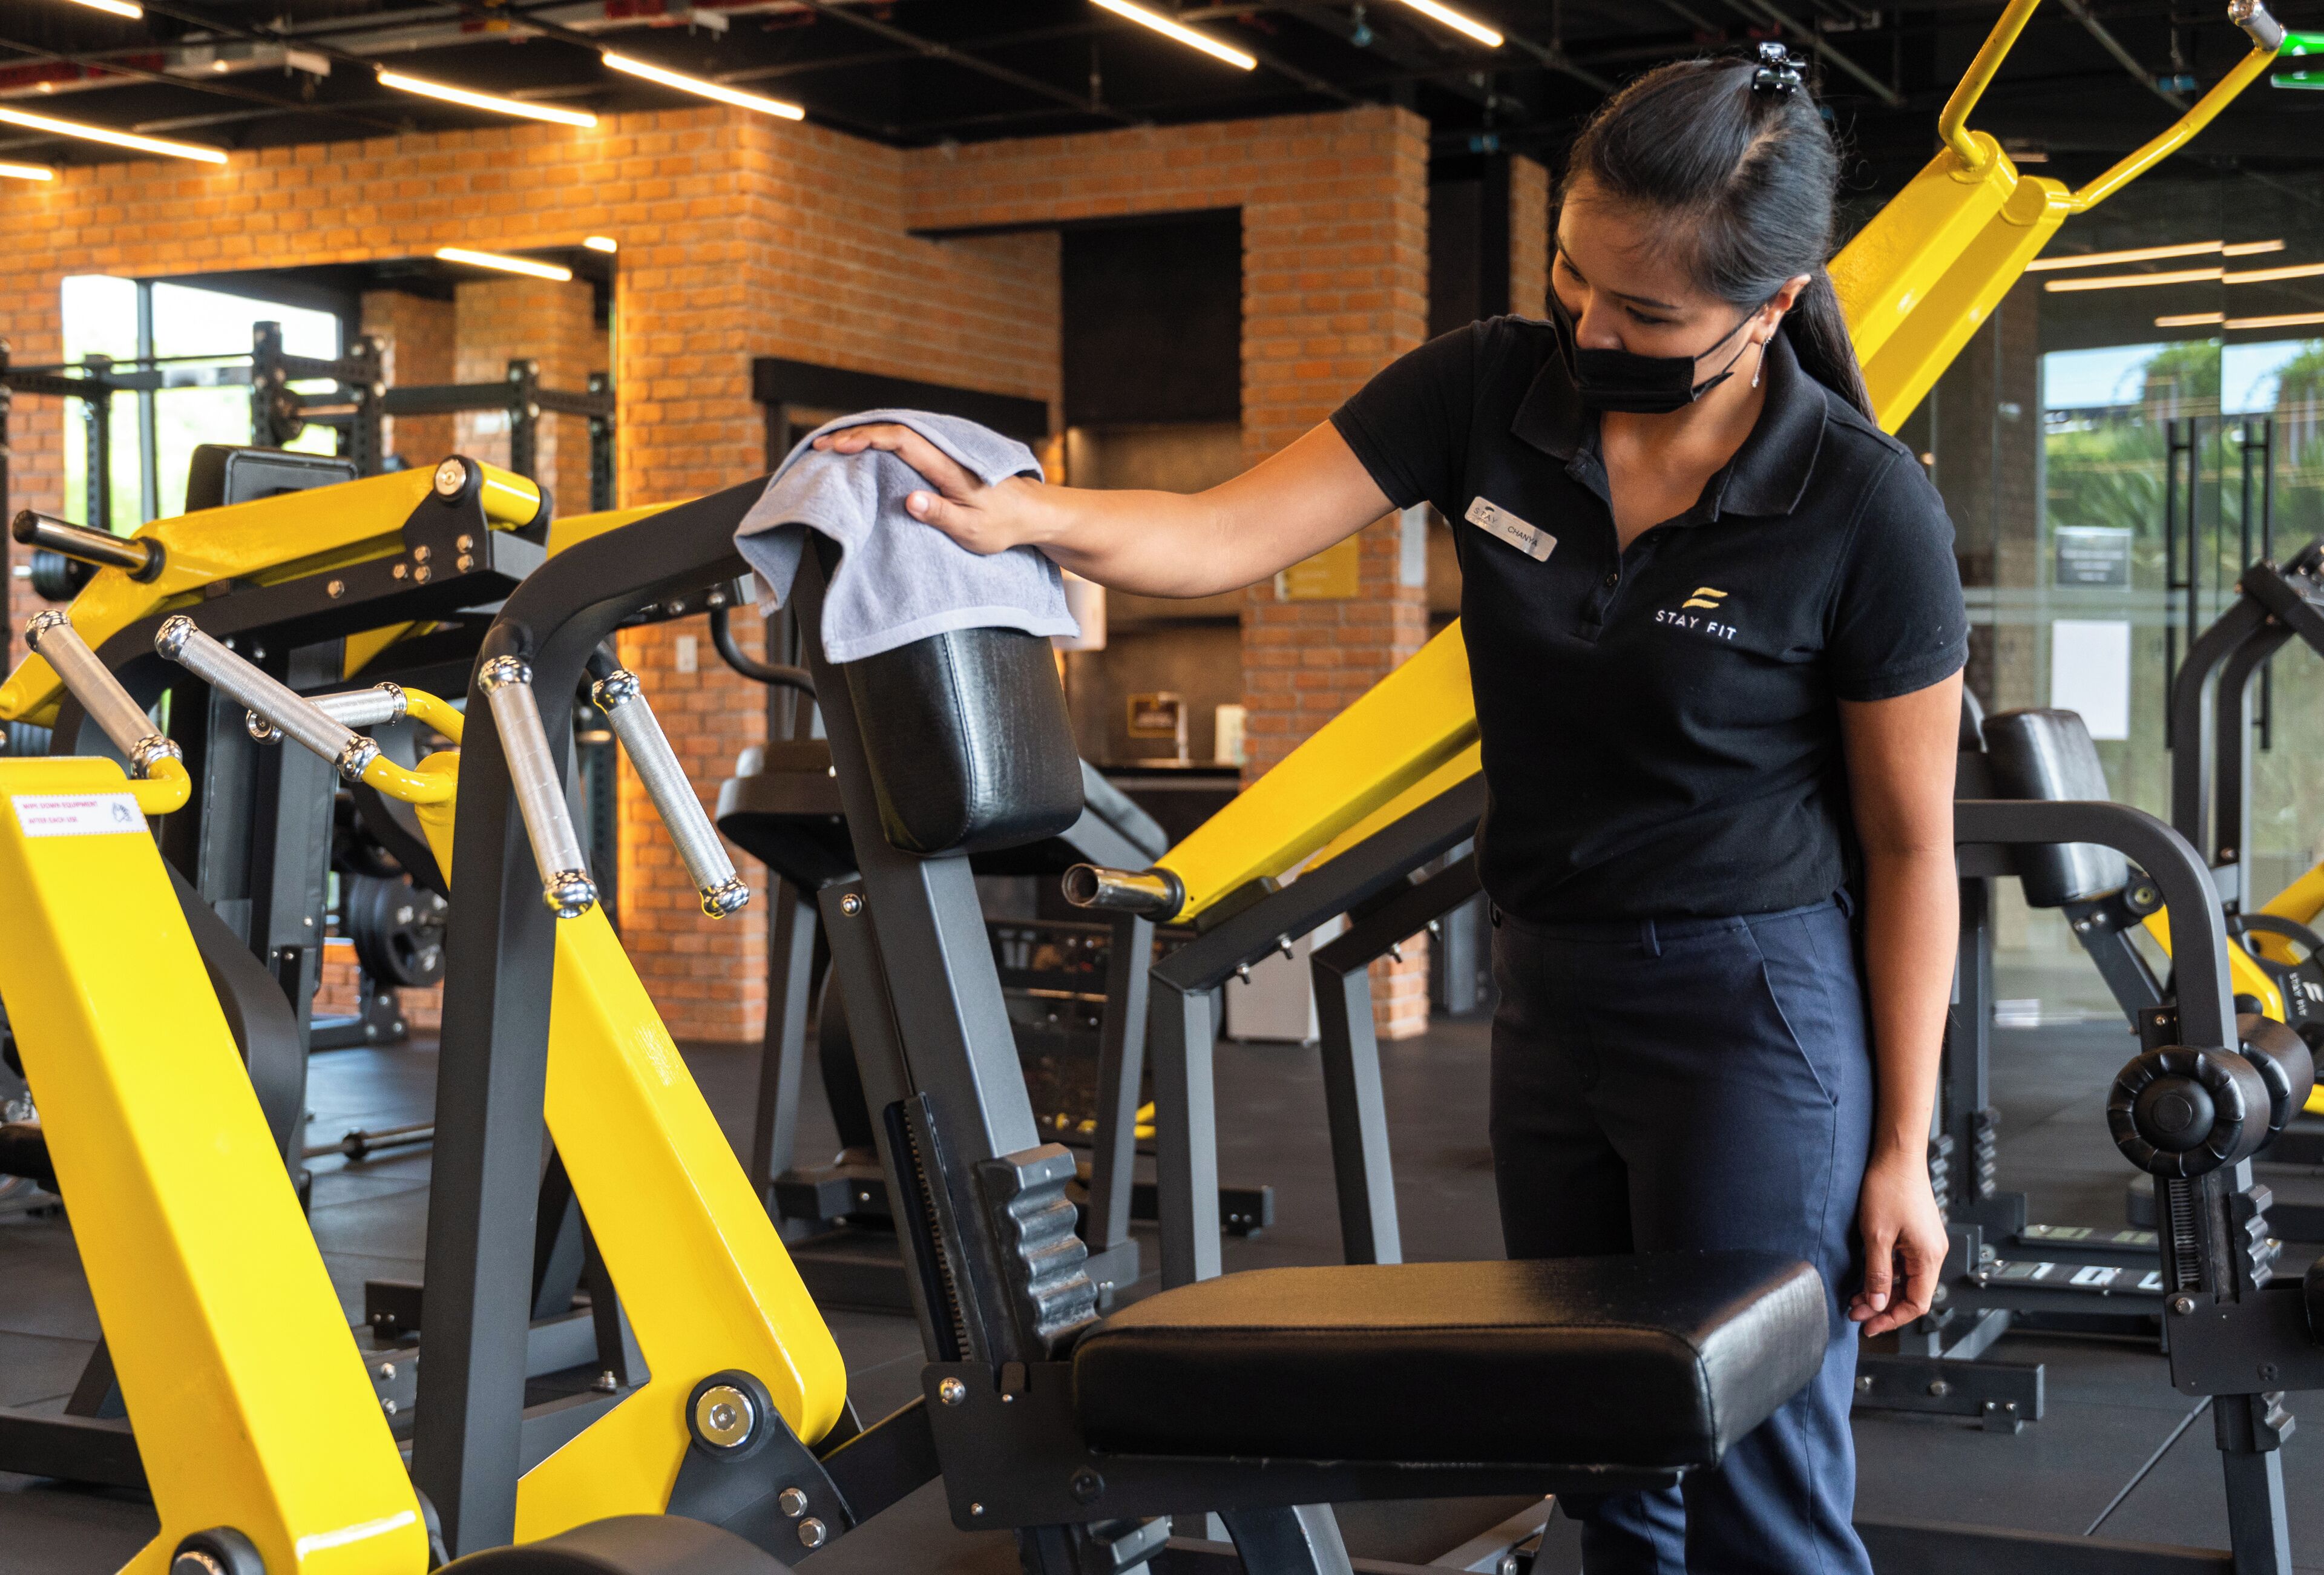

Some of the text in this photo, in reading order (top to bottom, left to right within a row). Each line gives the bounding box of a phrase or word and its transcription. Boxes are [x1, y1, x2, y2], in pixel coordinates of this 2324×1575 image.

[1474, 507, 1497, 524] STAY
[1508, 526, 1538, 547] CHANYA
[1655, 610, 1736, 640] STAY FIT
[2289, 972, 2307, 1016] STAY FIT
